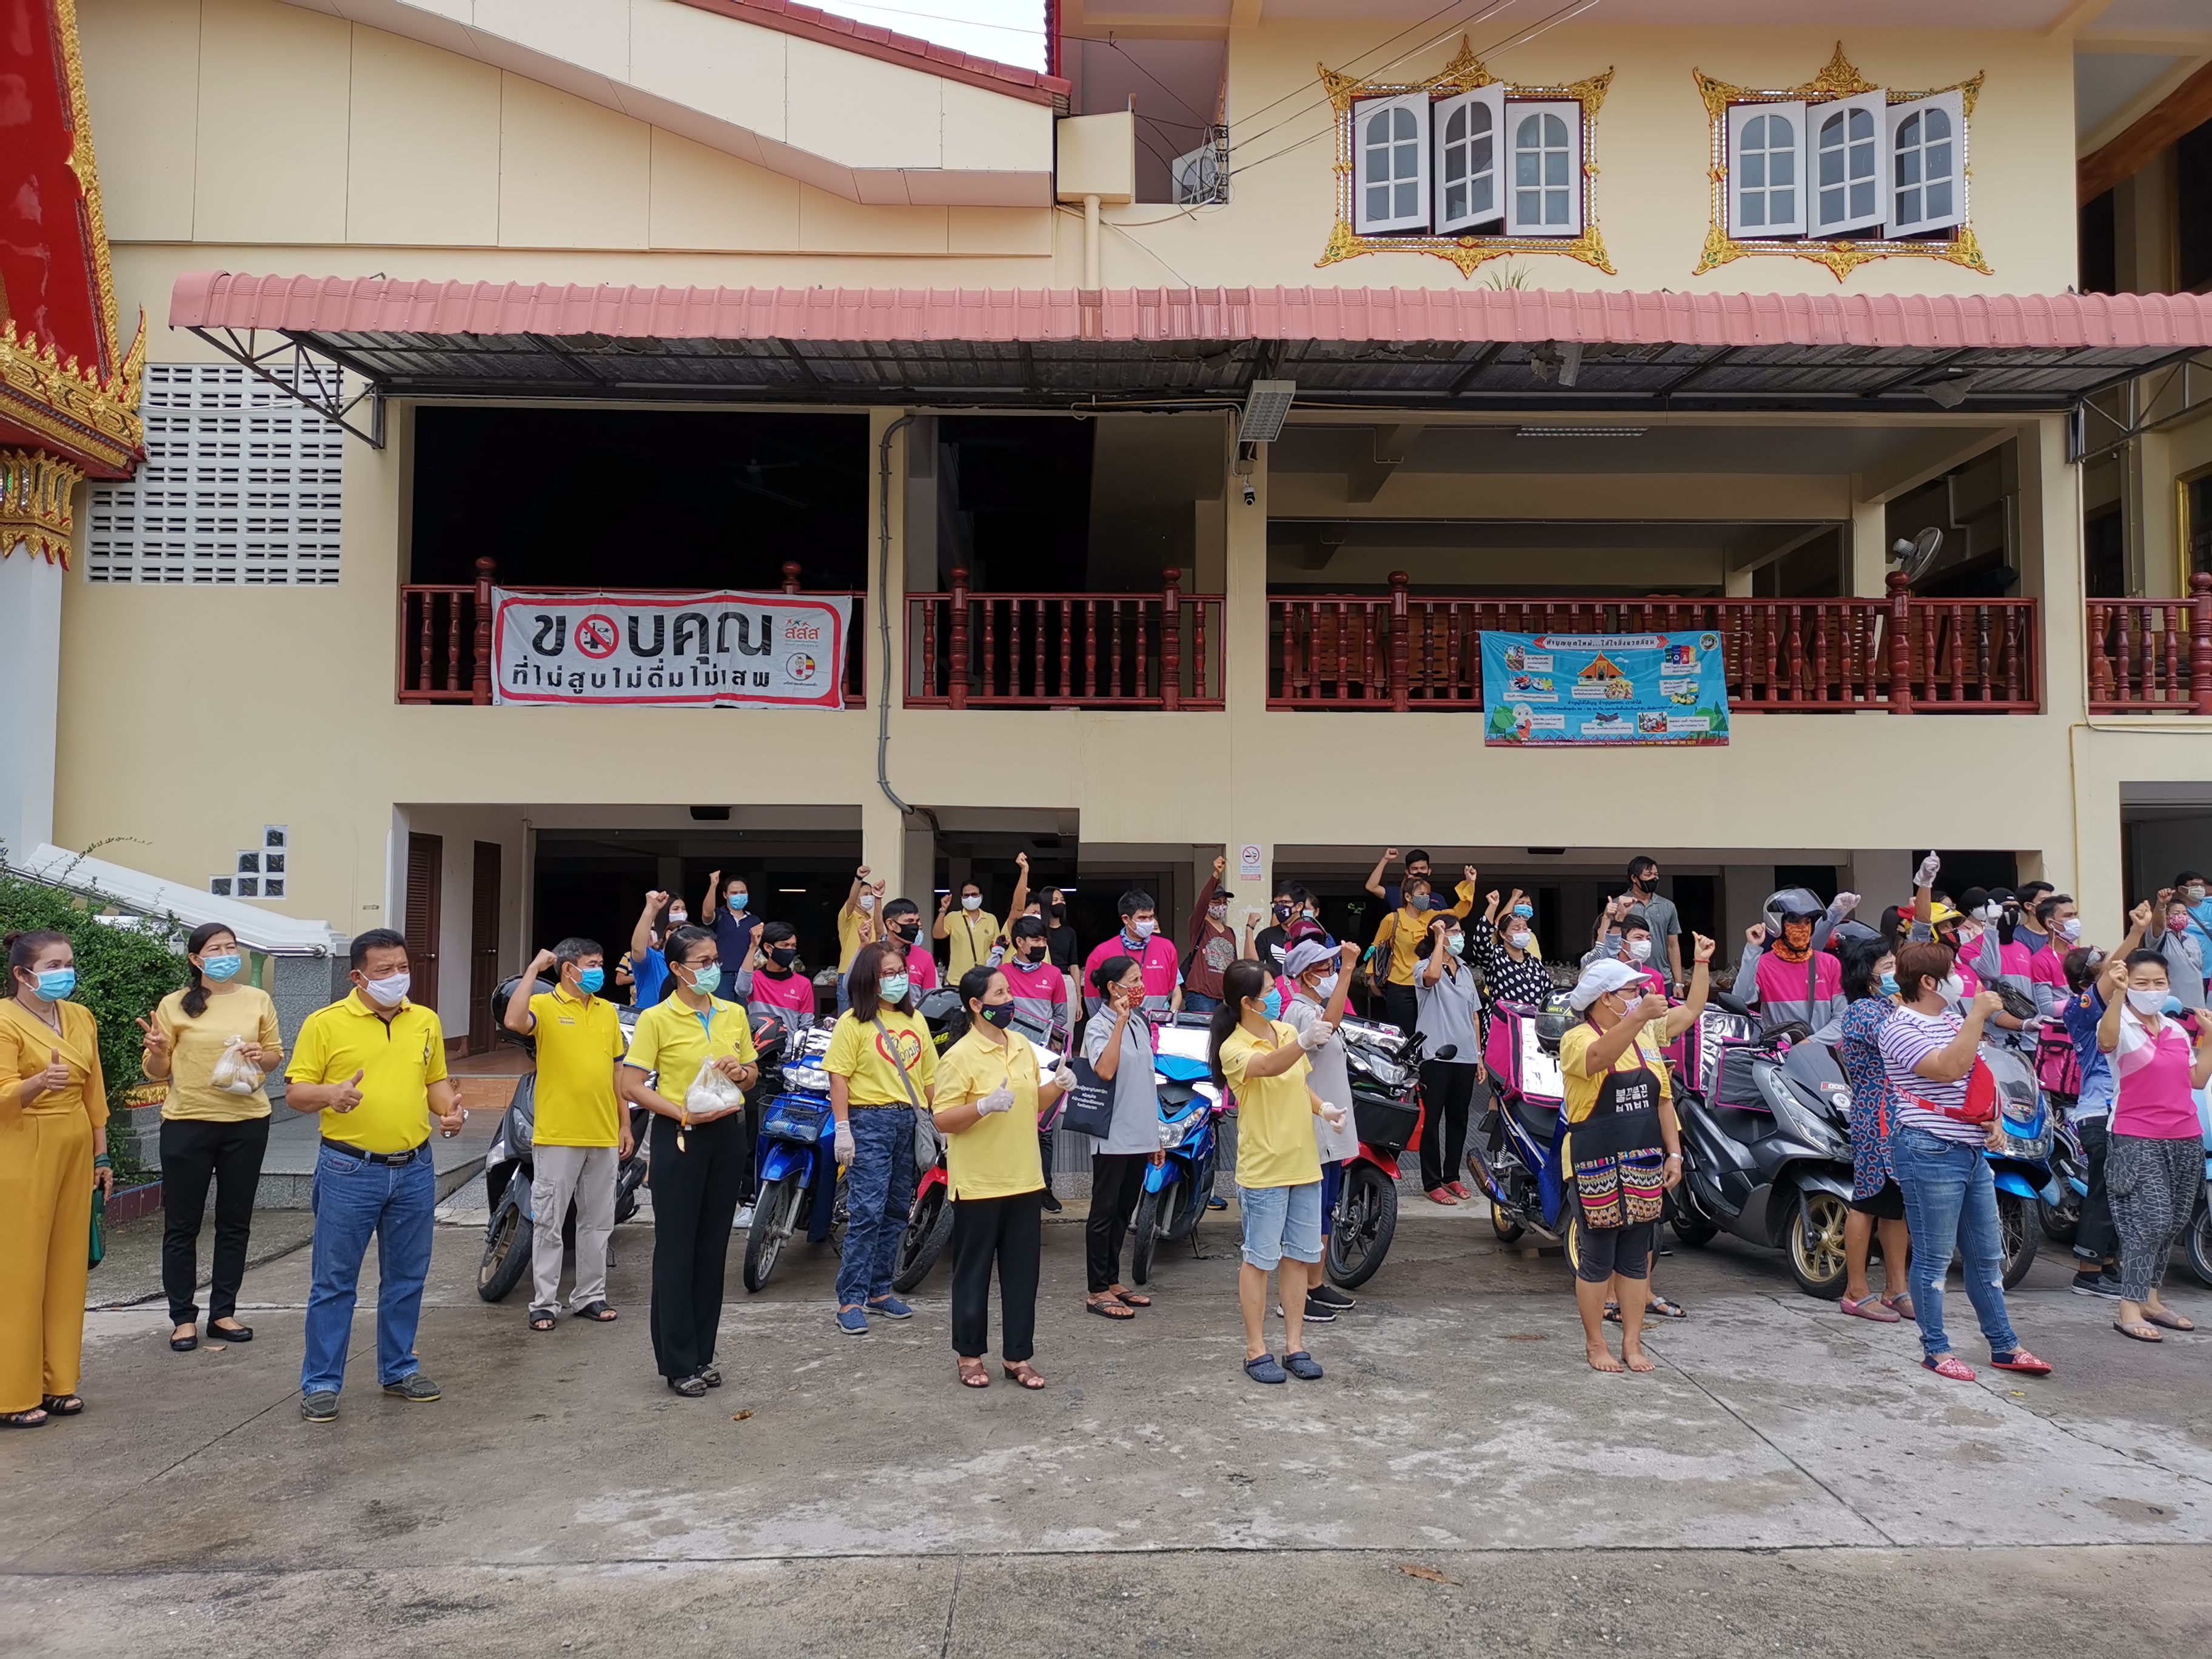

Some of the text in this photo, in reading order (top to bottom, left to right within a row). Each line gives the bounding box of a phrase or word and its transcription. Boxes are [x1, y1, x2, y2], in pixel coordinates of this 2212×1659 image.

[785, 626, 820, 639] สสส
[512, 655, 770, 694] ที่ไม่สูบไม่ดื่มไม่เสพ
